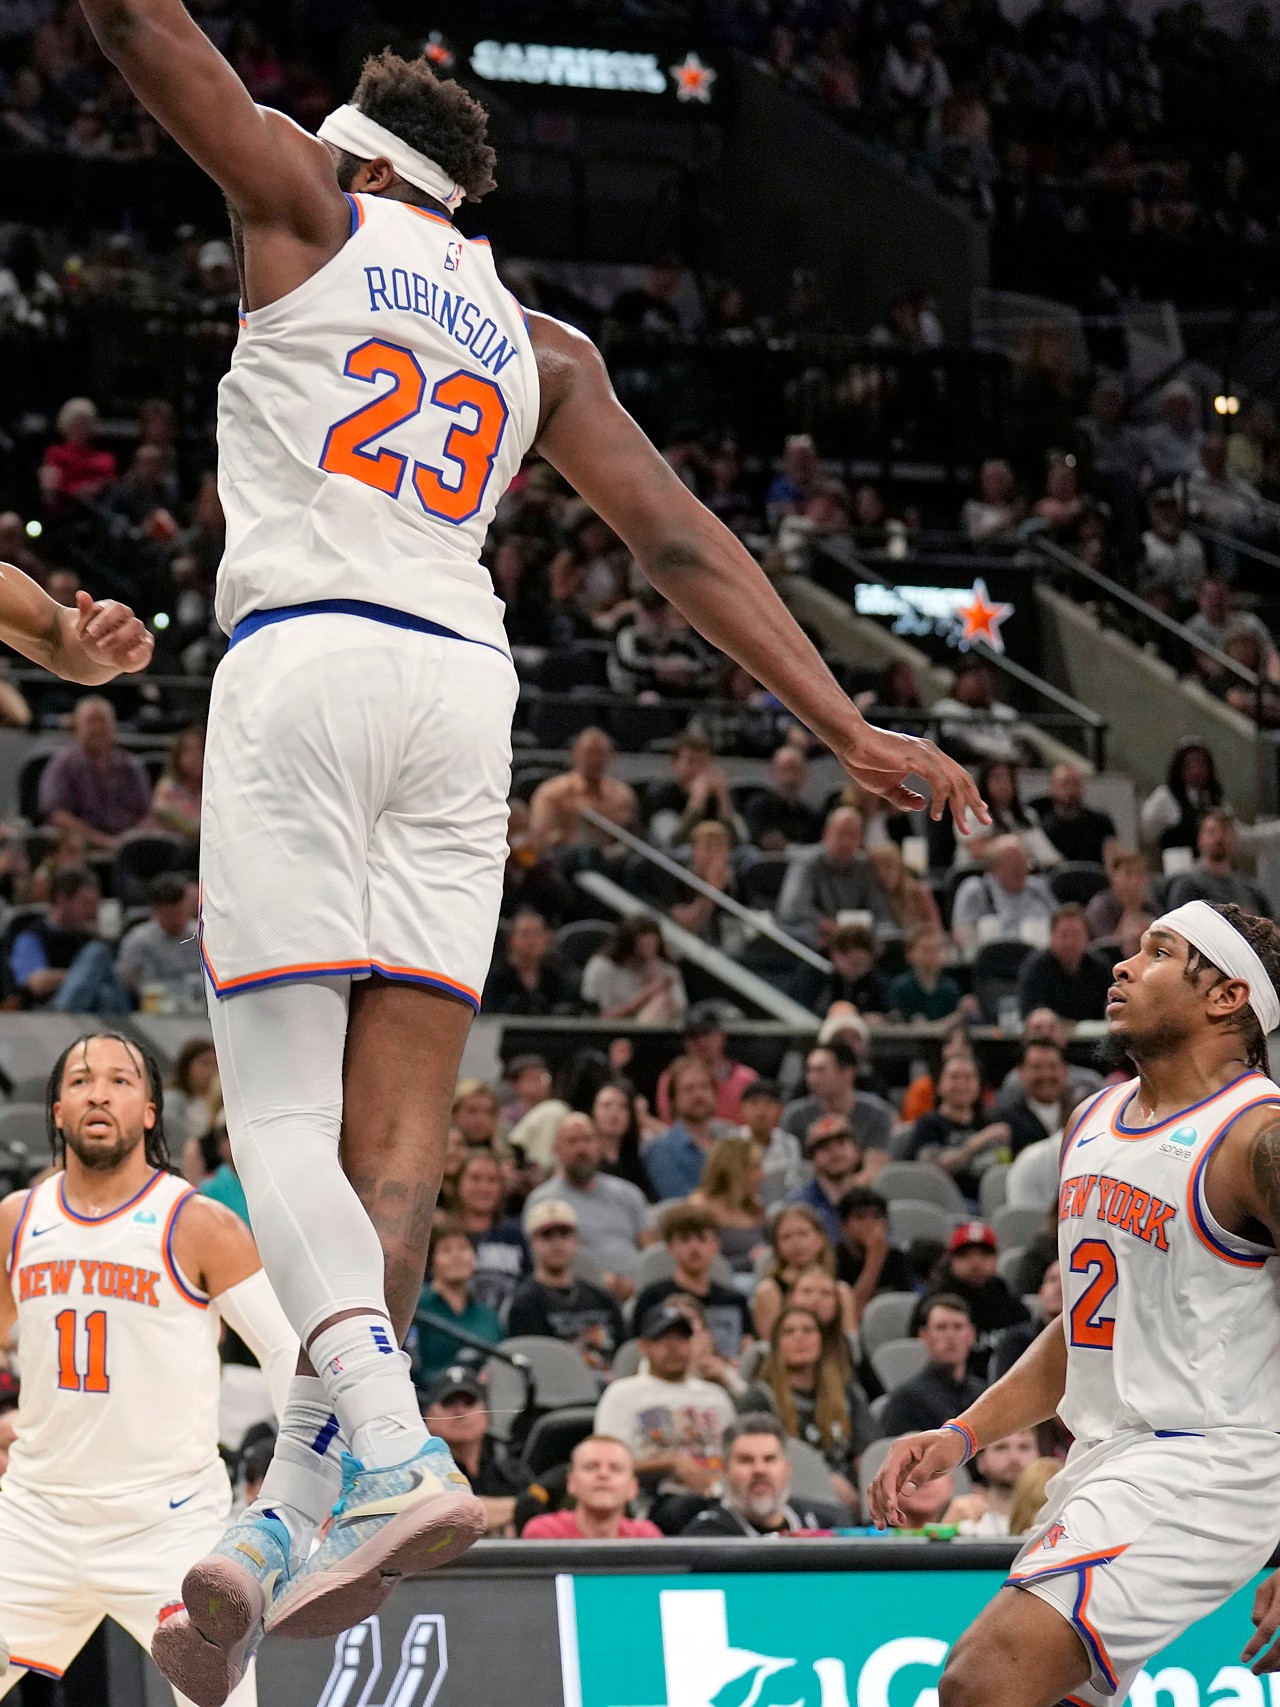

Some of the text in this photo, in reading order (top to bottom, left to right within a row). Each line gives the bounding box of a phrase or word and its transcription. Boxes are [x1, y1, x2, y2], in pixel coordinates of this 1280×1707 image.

[363, 266, 518, 376] ROBINSON
[318, 336, 509, 526] 23
[1097, 1174, 1177, 1254] YORK
[19, 1259, 161, 1309] NEW YORK
[1069, 1237, 1119, 1351] 2
[55, 1308, 110, 1394] 11
